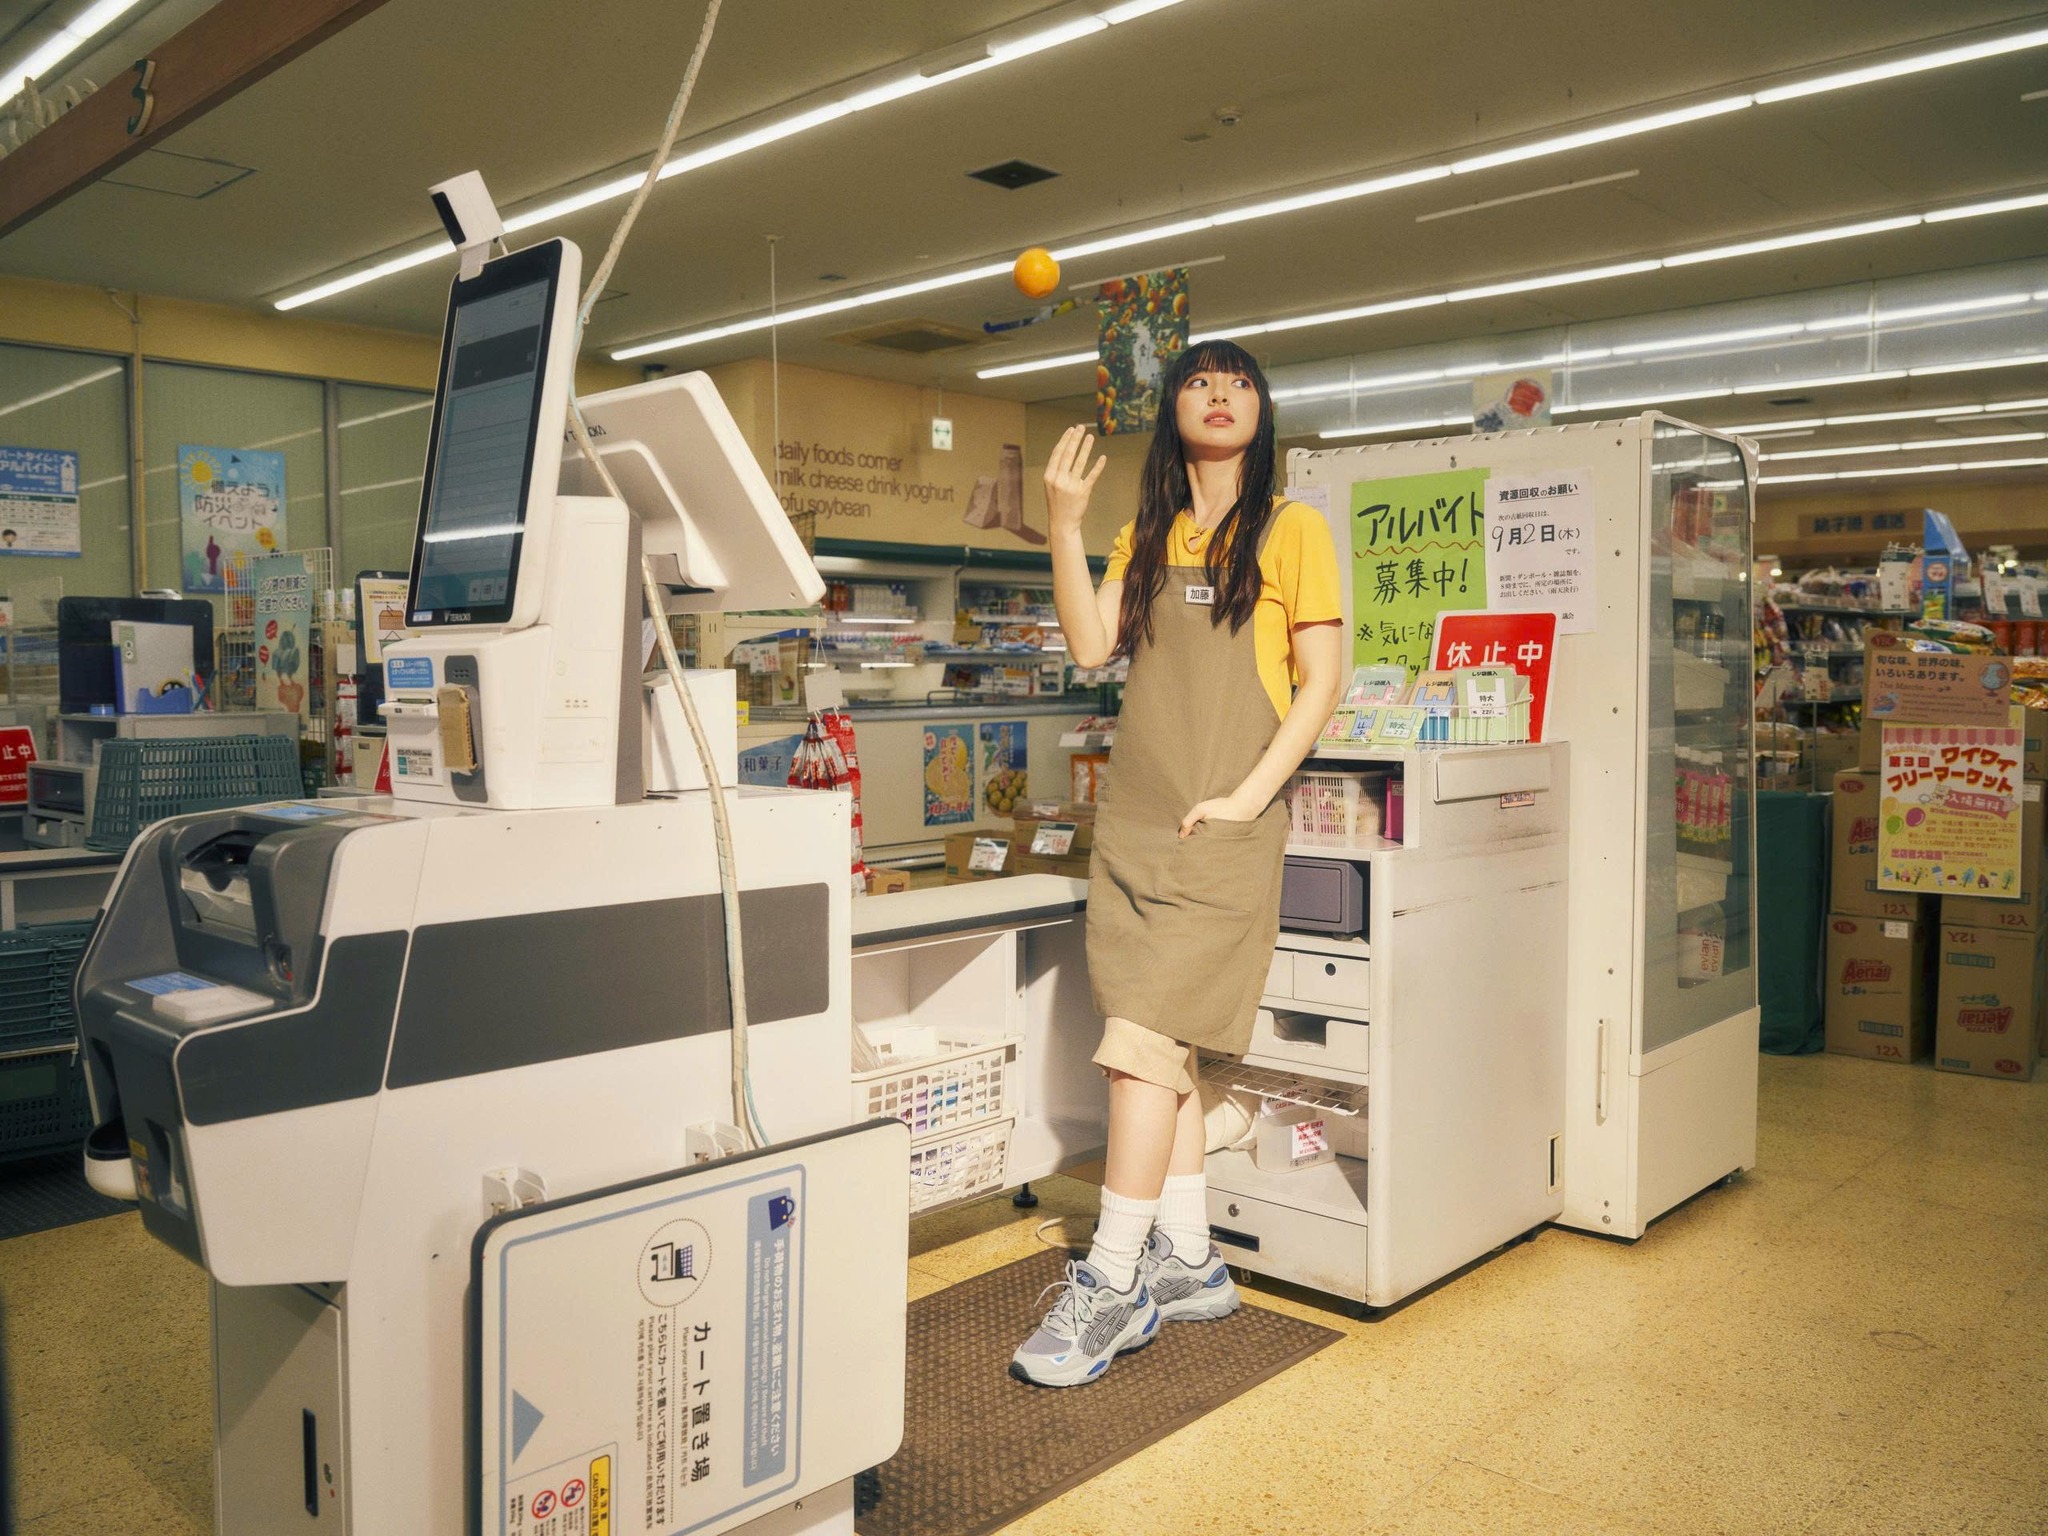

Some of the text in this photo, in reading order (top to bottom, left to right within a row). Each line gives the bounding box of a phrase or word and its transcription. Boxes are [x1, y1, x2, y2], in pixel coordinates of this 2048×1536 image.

[127, 58, 155, 137] 3
[773, 441, 903, 472] daily foods corner
[774, 468, 955, 504] milk cheese drink yoghurt
[1499, 483, 1578, 501] 資源回収のお願い
[809, 497, 871, 518] soybean
[1357, 491, 1484, 546] アルバイト
[1564, 547, 1580, 555] です。
[1446, 640, 1543, 668] 休止中
[1876, 668, 1965, 682] いろいろあります。
[1941, 747, 2018, 773] ワイワイ
[1887, 766, 2014, 793] フリーマーケット
[690, 1322, 711, 1482] カート置き場
[592, 1473, 601, 1507] CAUTION
